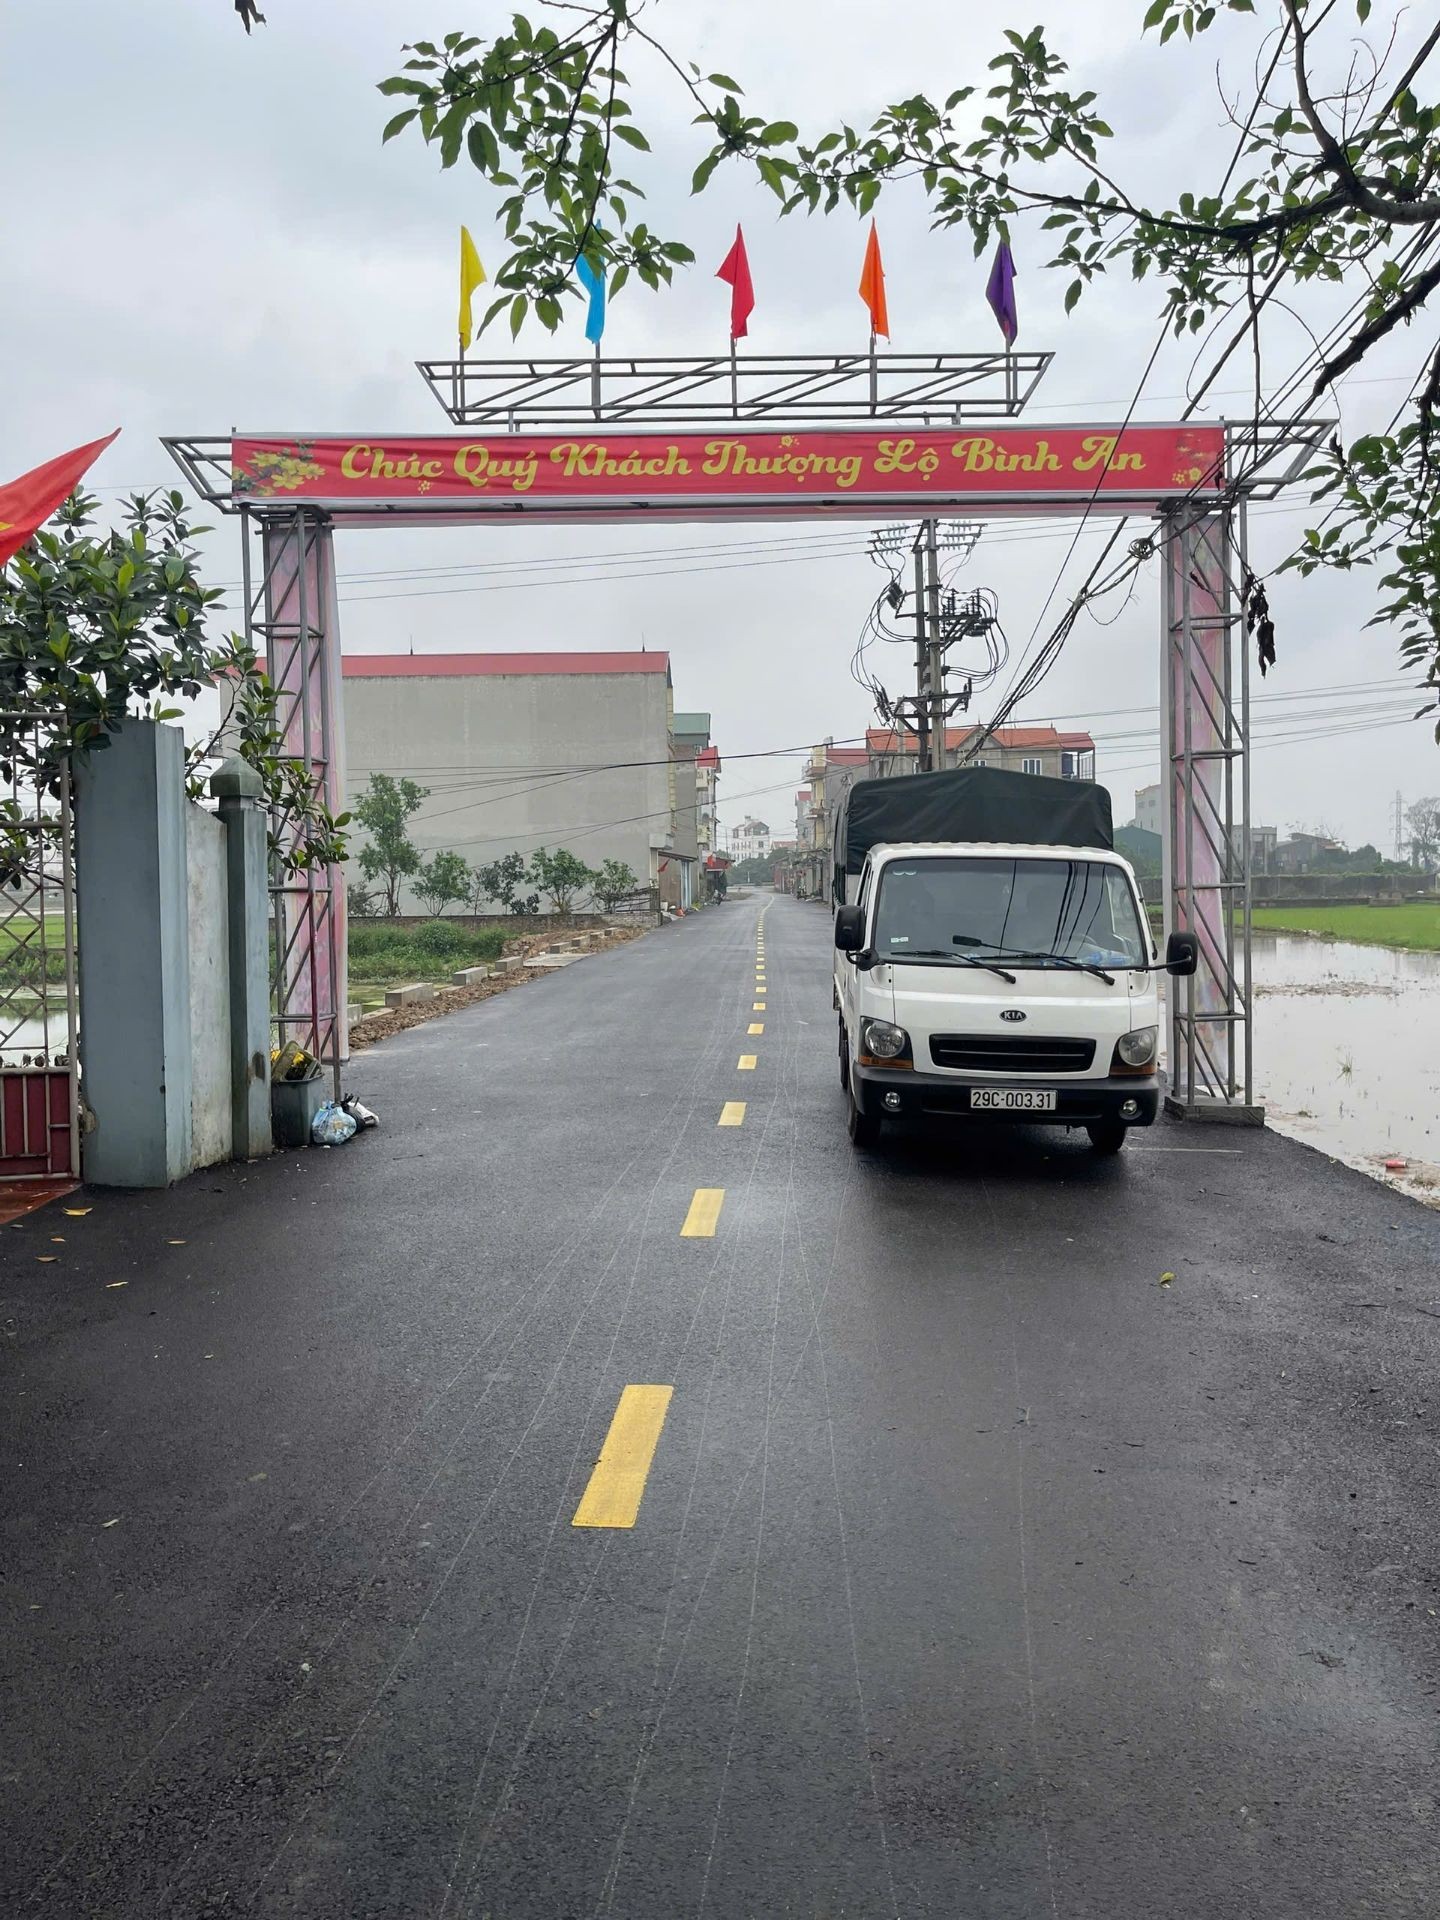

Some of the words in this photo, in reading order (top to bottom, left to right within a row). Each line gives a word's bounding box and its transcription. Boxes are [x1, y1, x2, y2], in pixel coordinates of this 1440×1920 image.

[341, 443, 445, 480] Chúc
[453, 443, 539, 491] Quý
[549, 441, 693, 477] Khách
[701, 440, 863, 488] Thượng
[873, 438, 940, 481] Lộ
[951, 437, 1063, 473] Bình
[1072, 435, 1147, 471] An
[1004, 1011, 1023, 1020] KIA
[972, 1091, 1051, 1109] 29C-003.31
